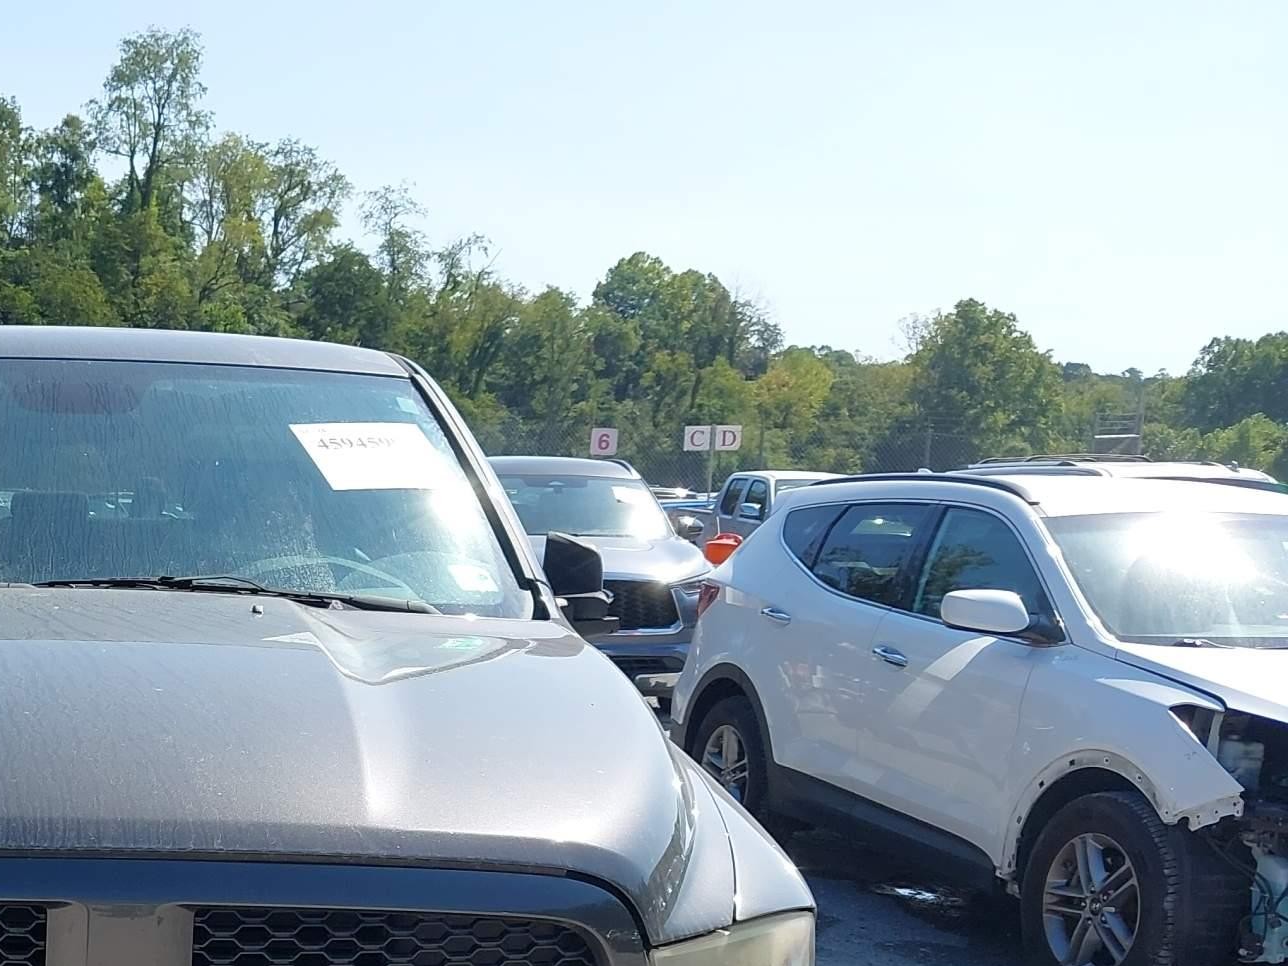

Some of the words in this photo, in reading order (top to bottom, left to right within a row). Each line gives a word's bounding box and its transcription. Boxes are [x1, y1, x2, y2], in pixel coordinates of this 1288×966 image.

[597, 433, 611, 451] 6
[690, 430, 705, 447] C
[721, 430, 737, 447] D
